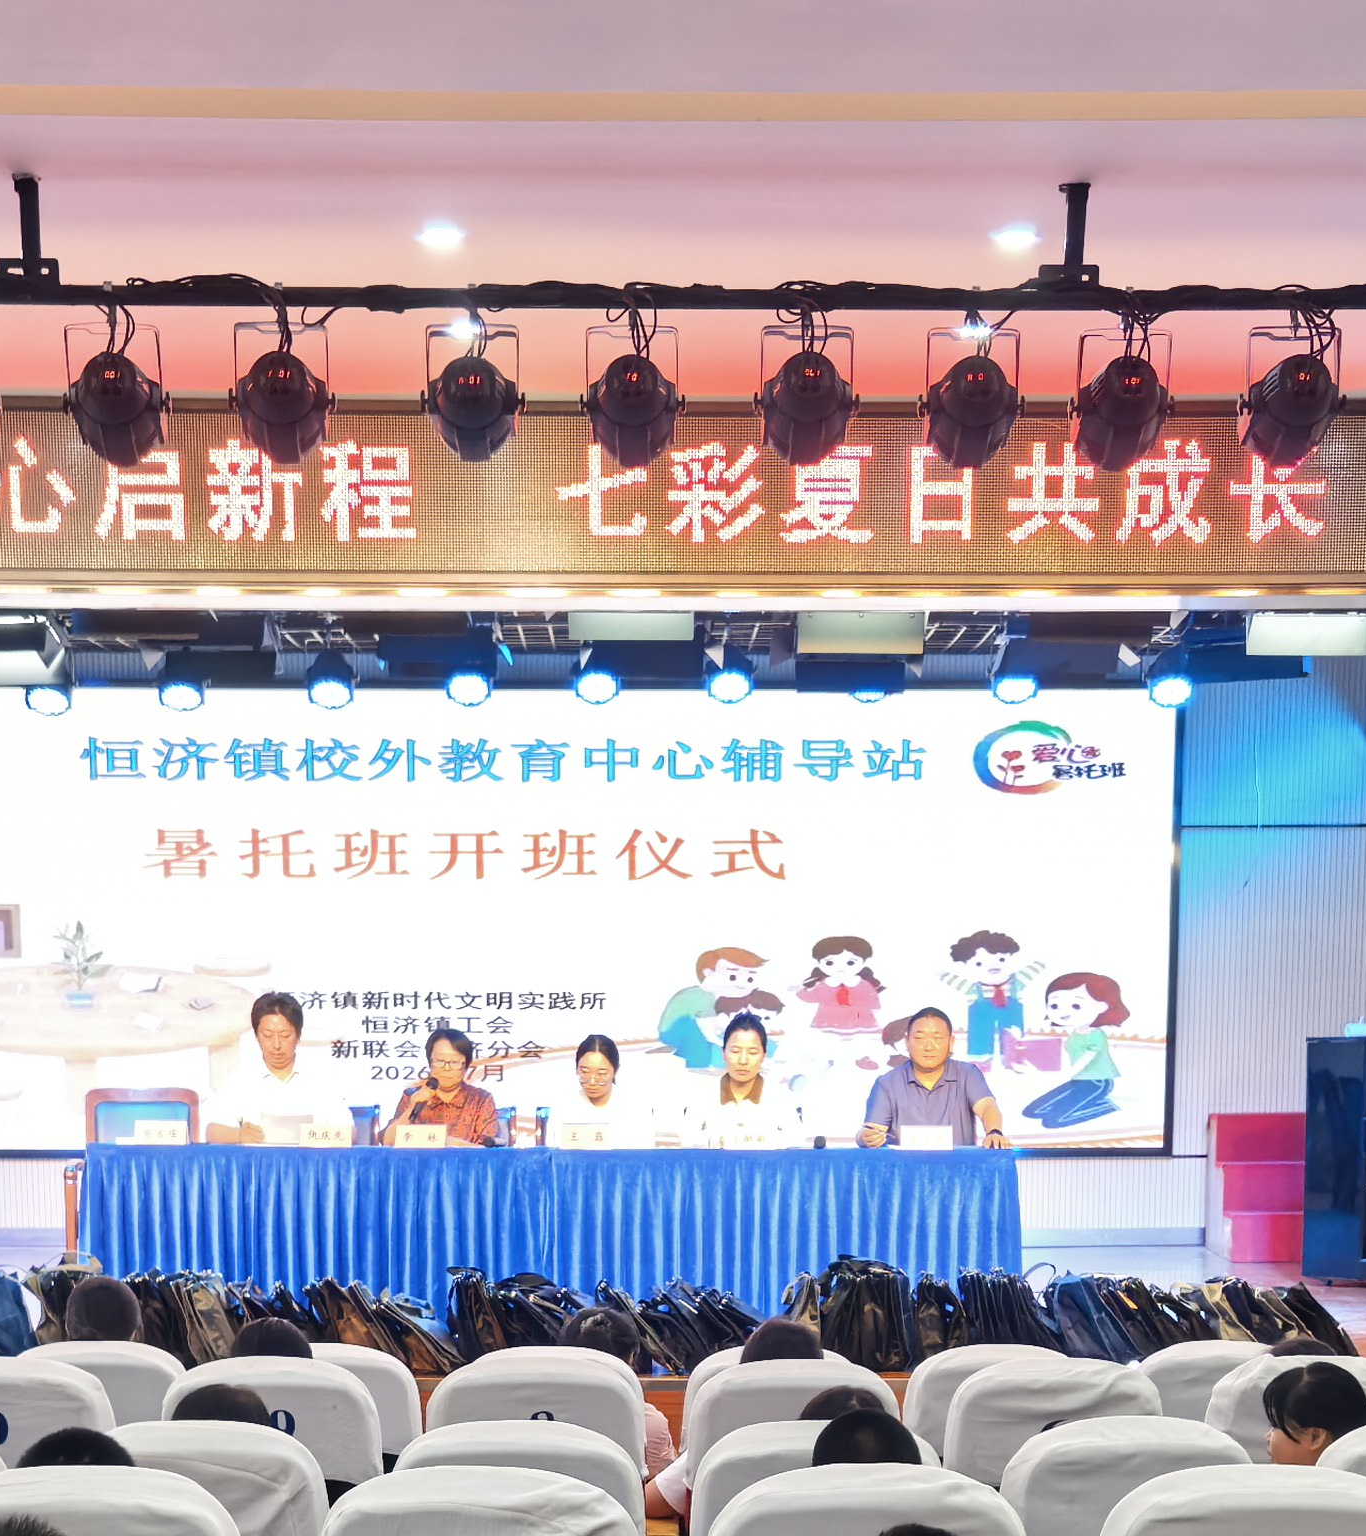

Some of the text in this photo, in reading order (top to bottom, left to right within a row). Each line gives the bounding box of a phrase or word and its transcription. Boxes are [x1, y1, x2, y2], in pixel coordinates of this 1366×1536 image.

[556, 438, 1327, 547] 七彩夏日共成长
[80, 736, 927, 784] 恒济镇校外教育中心辅导站
[144, 828, 786, 881] 暑托班开班仪式
[275, 989, 607, 1011] 济镇新时代文明实践所
